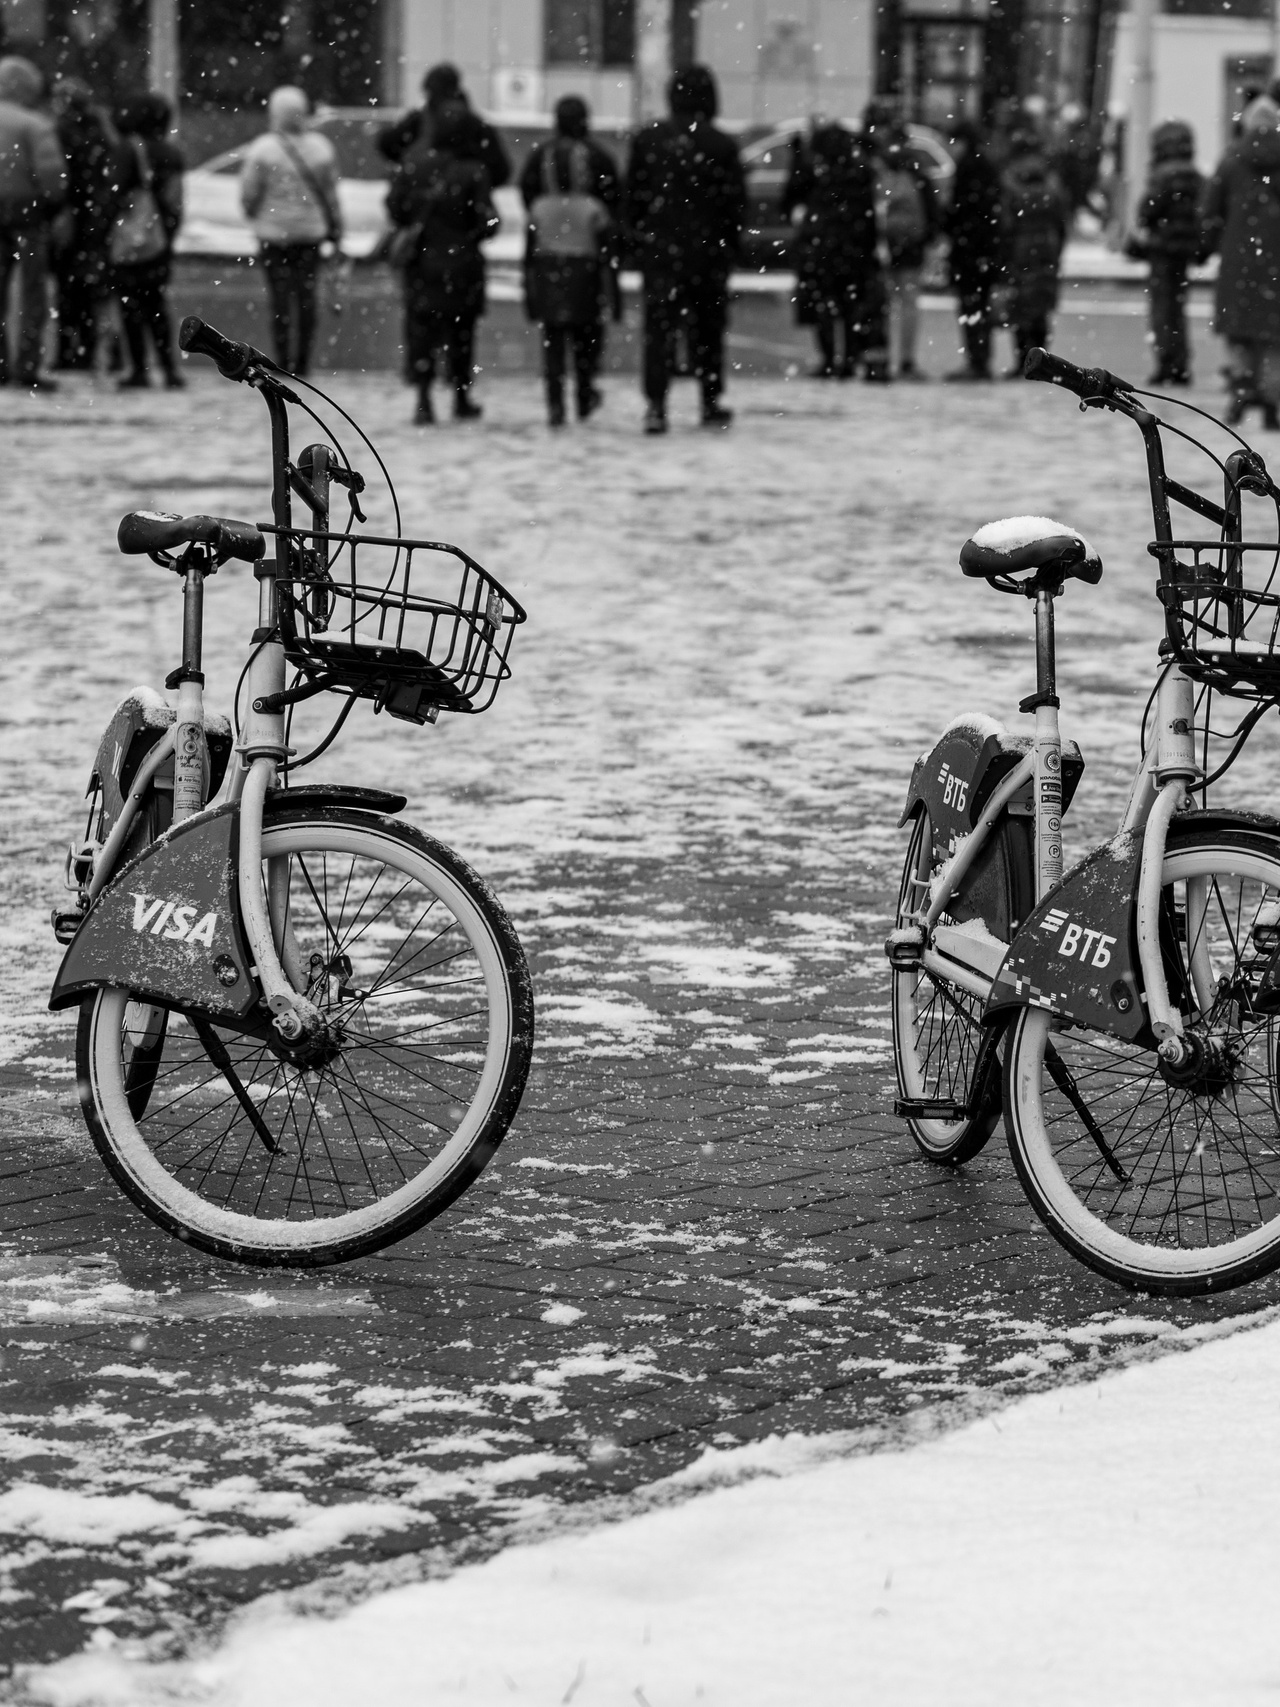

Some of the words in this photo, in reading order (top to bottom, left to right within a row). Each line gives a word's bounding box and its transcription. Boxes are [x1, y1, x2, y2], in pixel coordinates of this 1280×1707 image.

[942, 773, 969, 812] ВТБ
[127, 891, 218, 948] VISA
[1058, 922, 1117, 969] ВТБ
